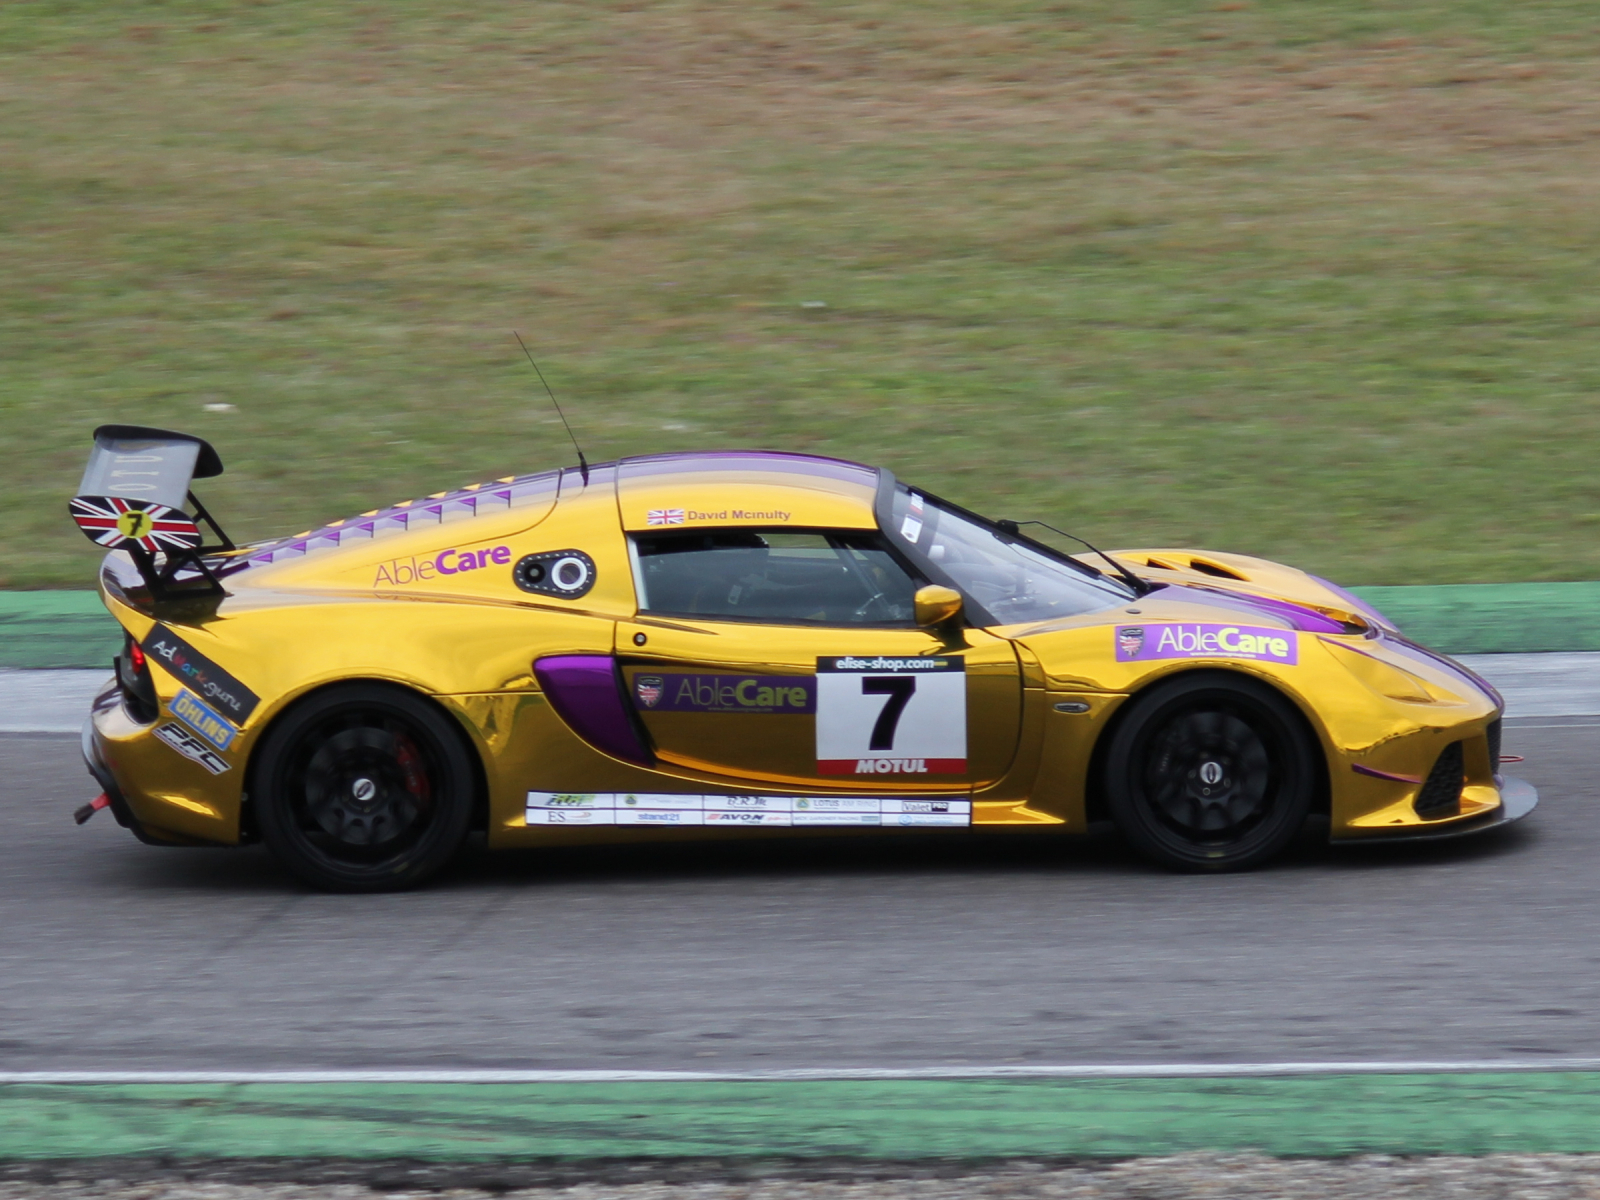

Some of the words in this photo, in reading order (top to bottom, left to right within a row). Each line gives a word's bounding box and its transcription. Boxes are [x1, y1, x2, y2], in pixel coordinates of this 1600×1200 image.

[126, 513, 143, 537] 7
[688, 510, 727, 520] David
[373, 545, 511, 588] AbleCare
[1156, 625, 1289, 657] AbleCare
[835, 656, 935, 671] elise-shop.com
[675, 677, 807, 707] AbleCare
[175, 692, 229, 745] ÖHLINS
[861, 675, 916, 751] 7
[159, 721, 231, 774] PFC
[854, 759, 928, 773] MOTUL
[547, 811, 566, 822] ES
